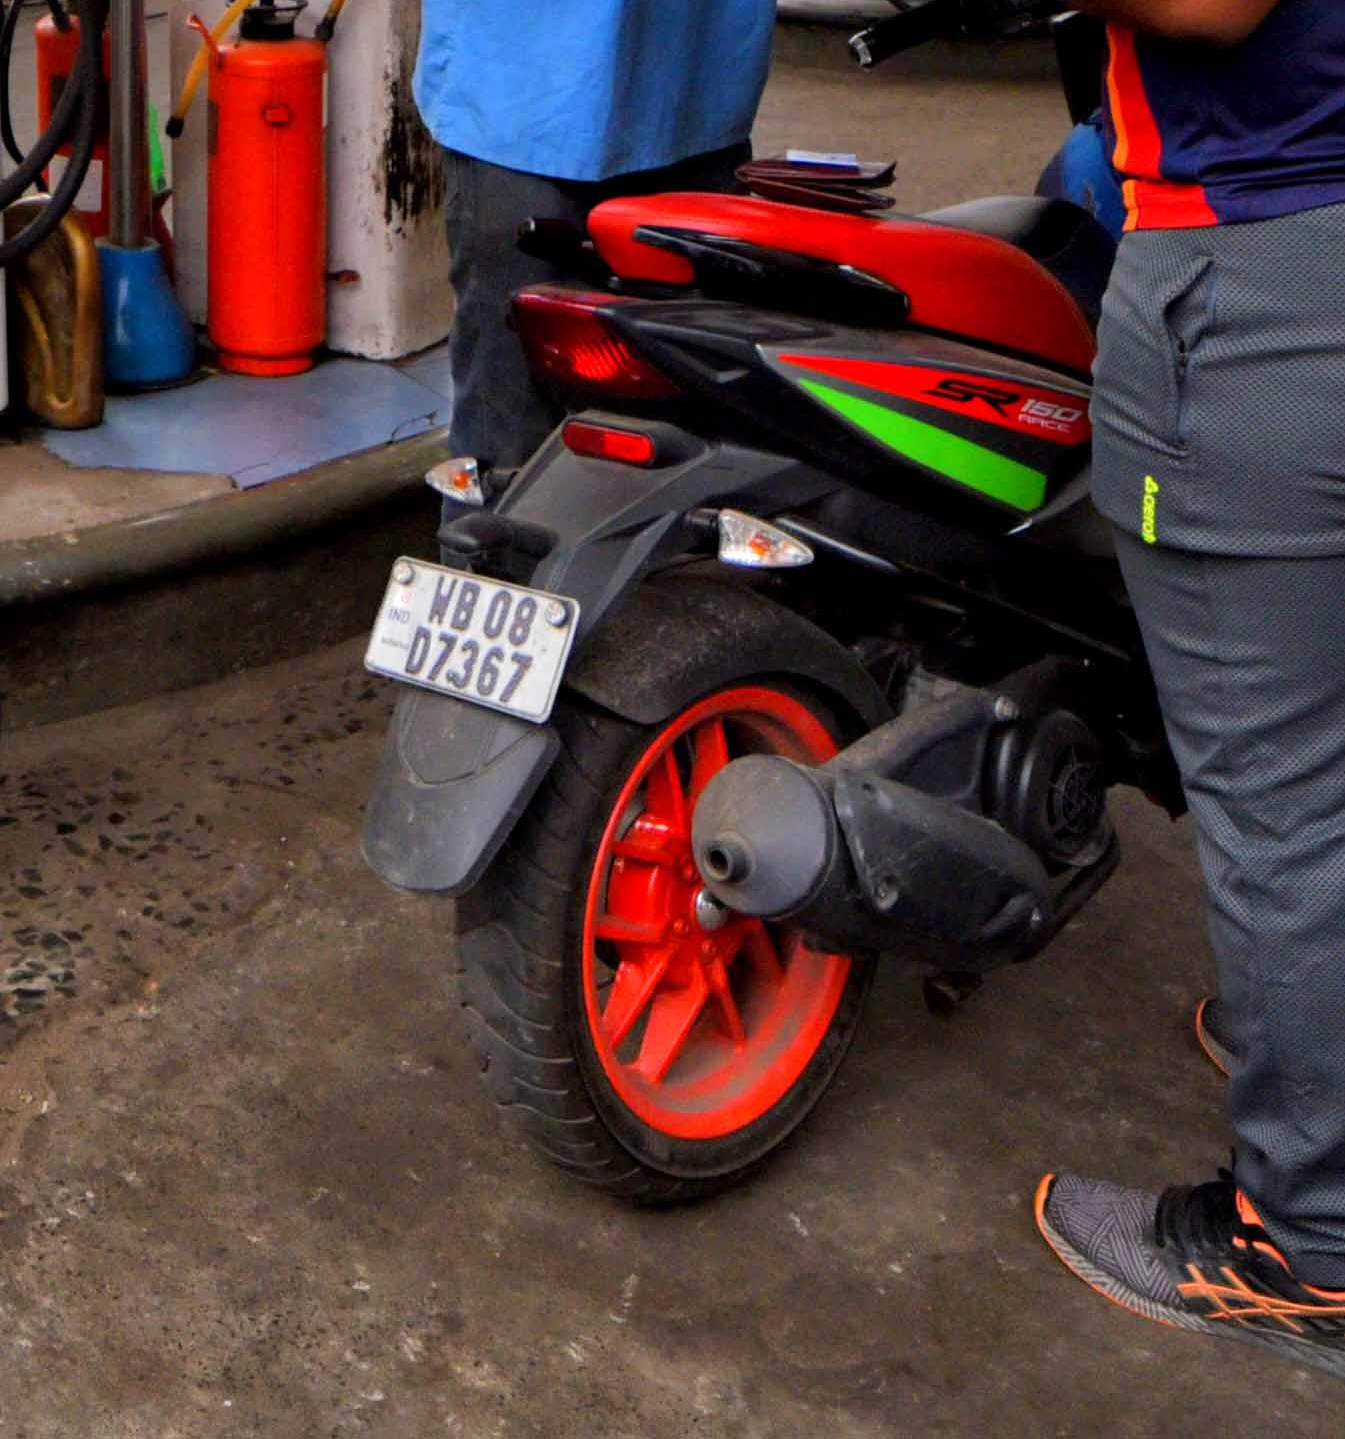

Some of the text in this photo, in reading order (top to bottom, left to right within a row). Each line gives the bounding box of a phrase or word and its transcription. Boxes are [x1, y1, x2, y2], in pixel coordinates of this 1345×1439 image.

[920, 379, 1020, 418] SR
[1018, 414, 1072, 433] RACE
[388, 607, 411, 625] IND
[428, 575, 538, 646] WB 08
[404, 625, 534, 703] D7367
